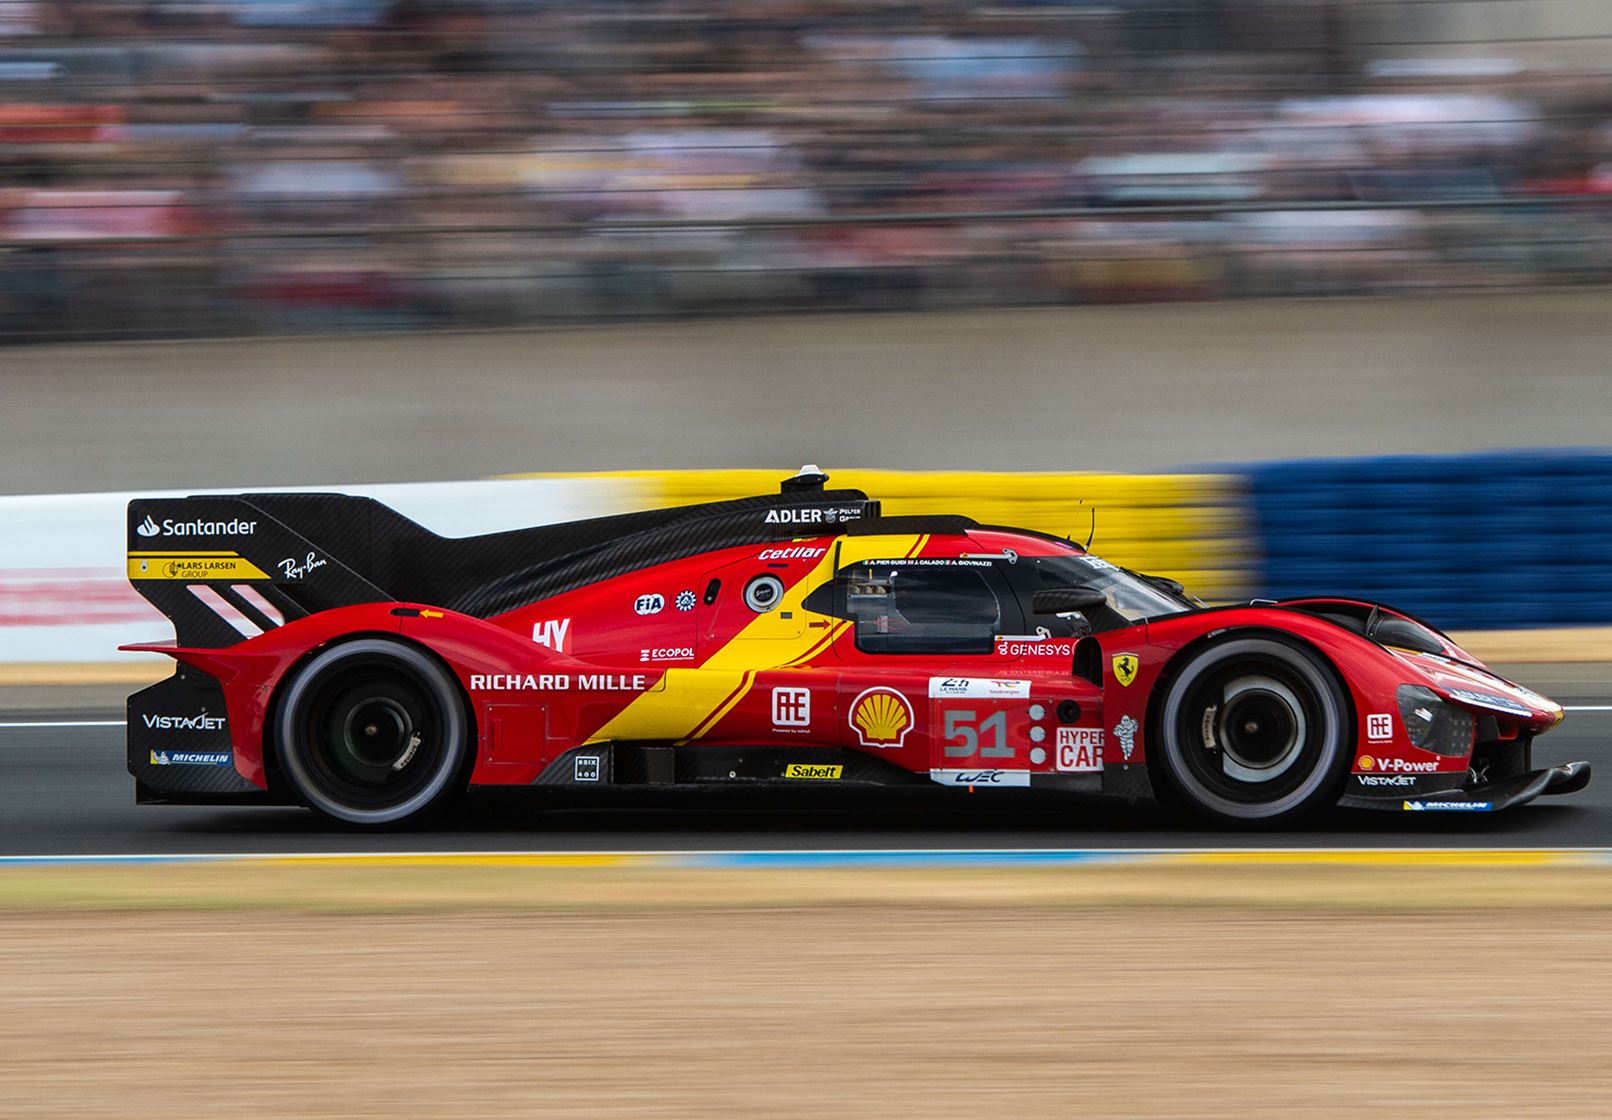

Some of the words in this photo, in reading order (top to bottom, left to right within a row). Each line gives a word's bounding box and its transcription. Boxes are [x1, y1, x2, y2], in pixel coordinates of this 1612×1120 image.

[765, 509, 821, 523] ADLER
[163, 518, 257, 536] Santander
[182, 562, 203, 570] LARS
[204, 562, 236, 570] LARSEN
[652, 648, 694, 657] ECOPOL
[1010, 644, 1071, 656] GENESYS
[470, 674, 569, 690] RICHARD
[578, 674, 645, 690] MILLE
[944, 710, 1016, 758] 51
[172, 754, 229, 763] MICHELIN
[1061, 745, 1105, 767] CAR
[791, 765, 837, 778] Sabelt
[1377, 758, 1439, 772] V-Power
[955, 771, 1005, 783] WEC
